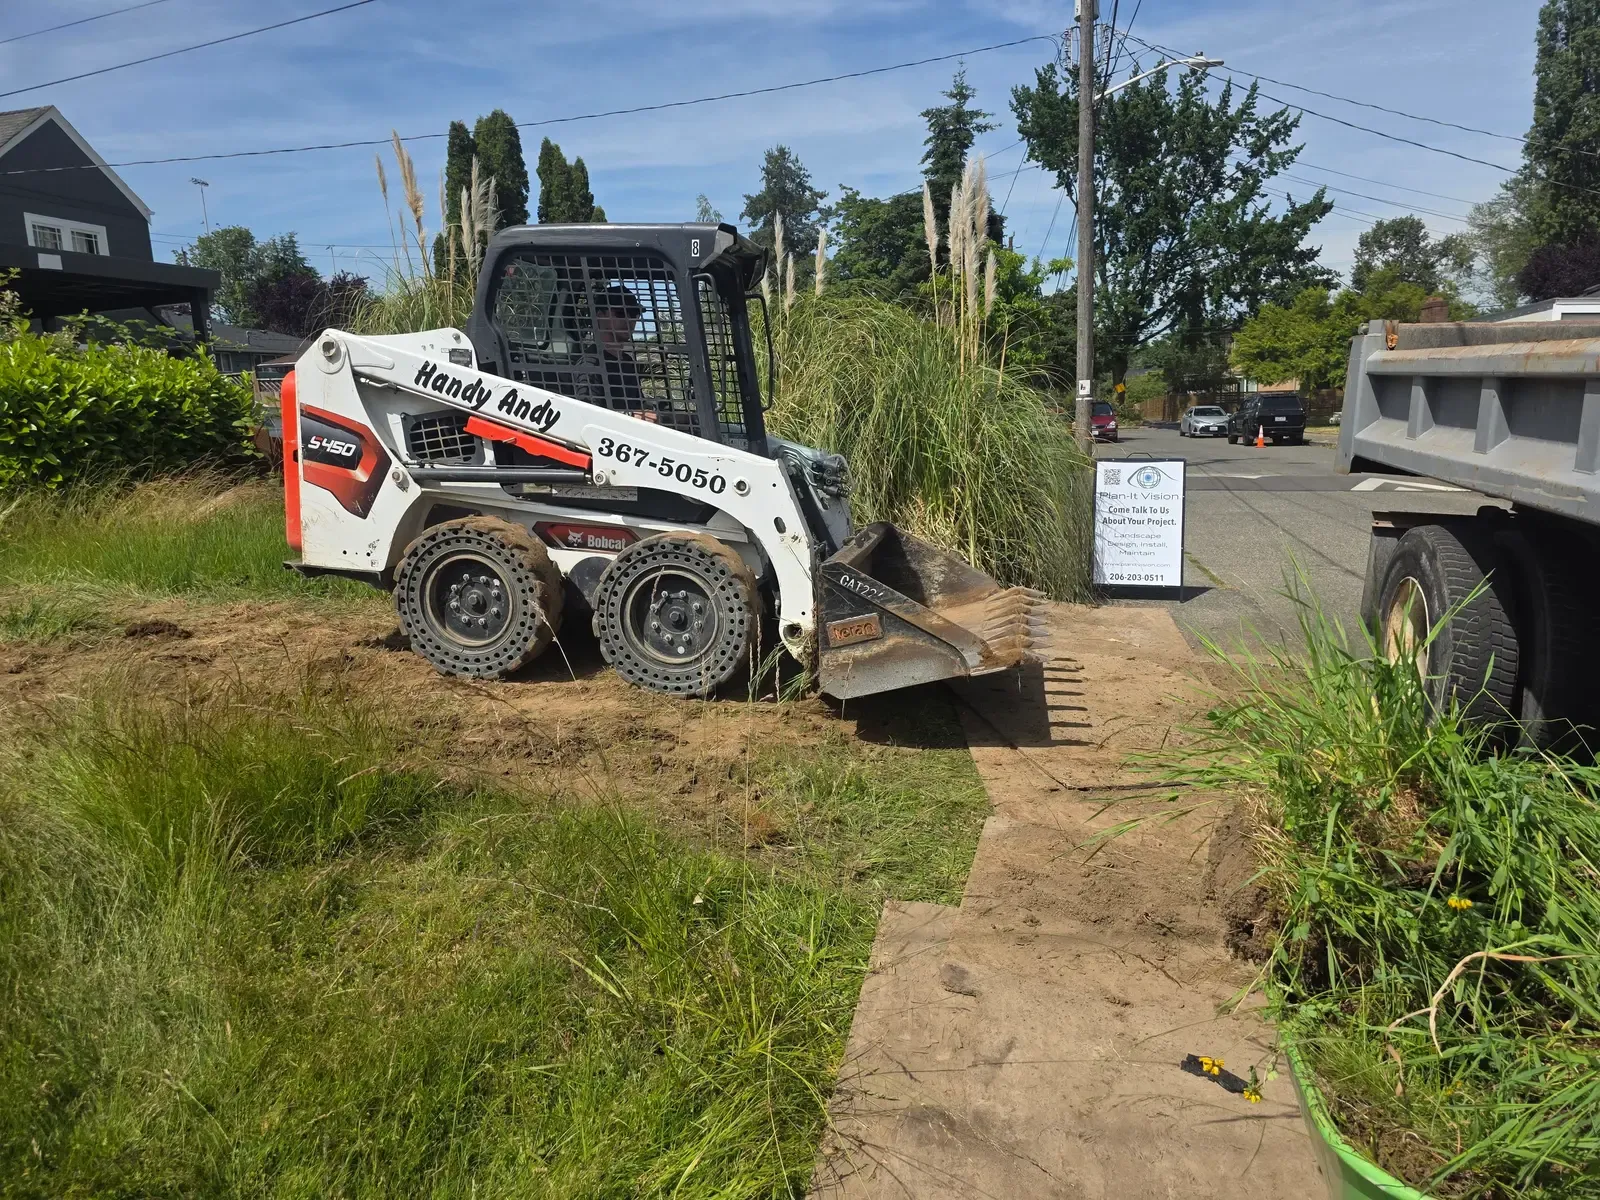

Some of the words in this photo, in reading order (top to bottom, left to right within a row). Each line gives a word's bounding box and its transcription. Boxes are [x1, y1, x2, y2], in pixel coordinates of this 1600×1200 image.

[692, 240, 699, 256] 8
[414, 360, 492, 411] Handy
[497, 388, 561, 433] Andy
[308, 435, 356, 457] S450
[598, 437, 726, 494] 367-5050
[1099, 491, 1138, 500] Plan-It
[1141, 492, 1179, 500] Vision
[1108, 505, 1130, 514] Come
[1132, 506, 1147, 514] Talk
[1149, 506, 1158, 514] To
[1160, 506, 1170, 514] Us
[1102, 516, 1126, 525] About
[1128, 517, 1145, 525] Your
[1147, 517, 1177, 527] Project.
[587, 534, 626, 550] Bobcat
[1114, 532, 1162, 540] Landscape
[1109, 572, 1164, 582] 206-203-0511
